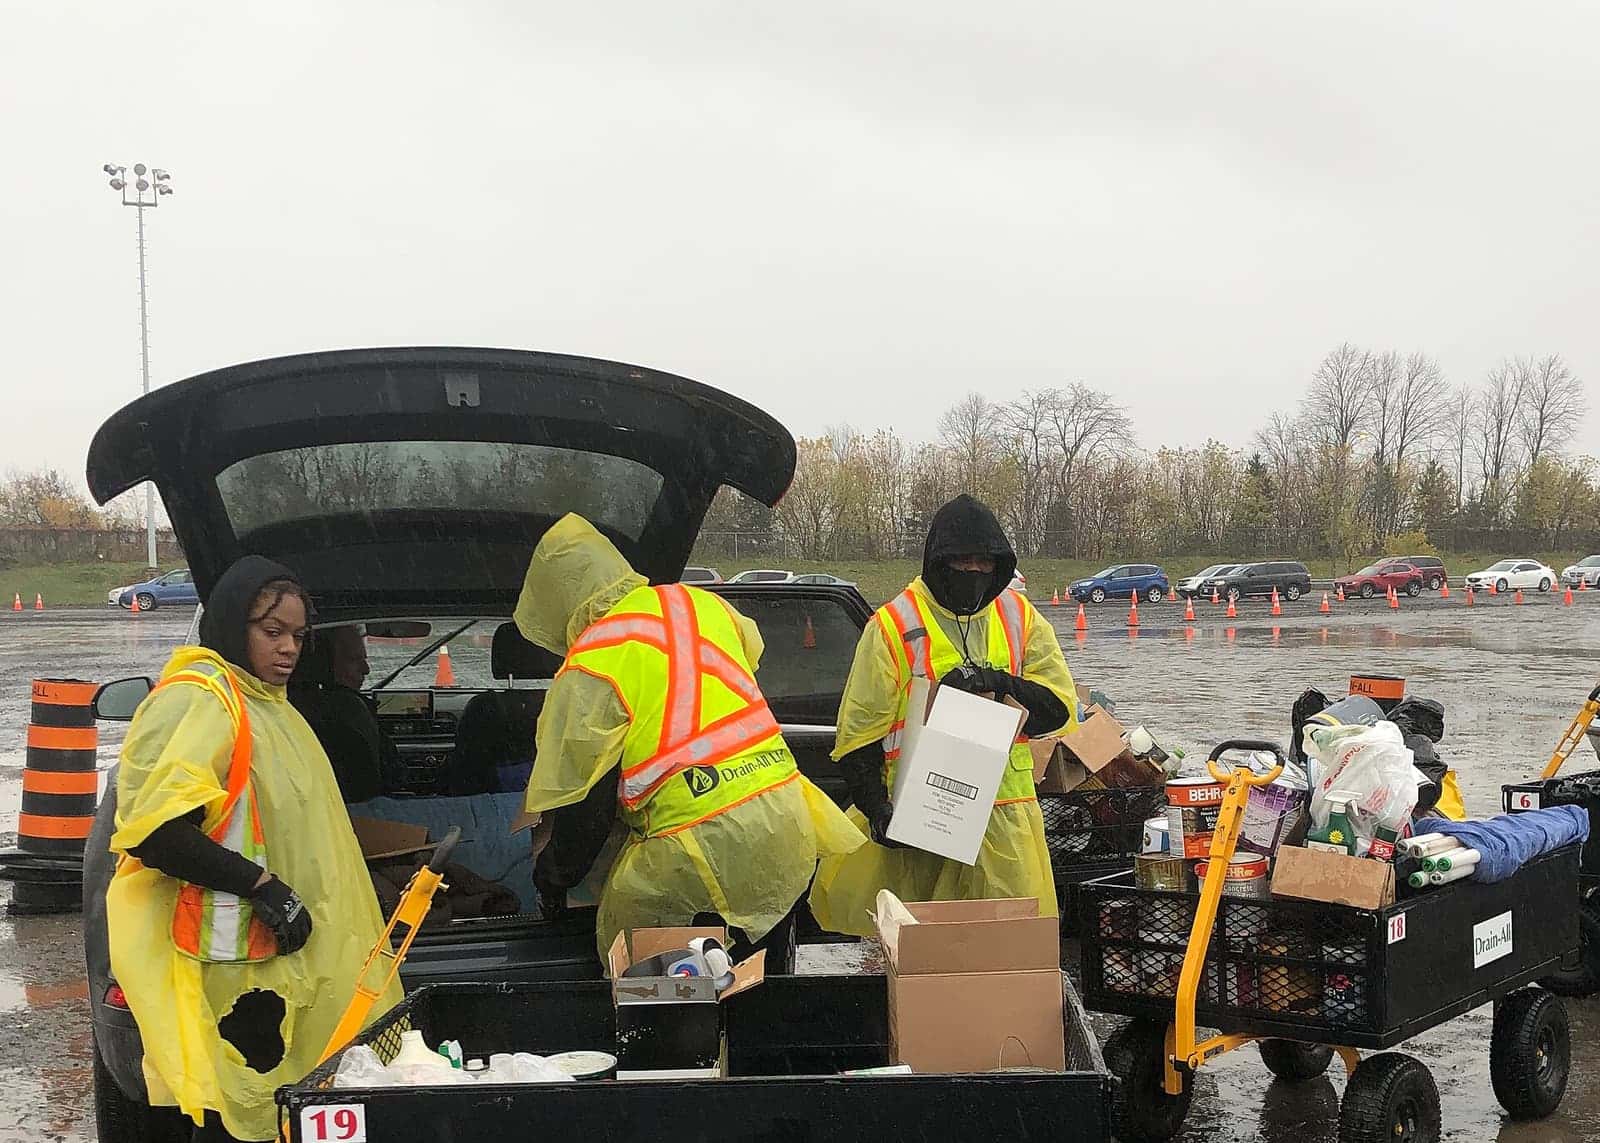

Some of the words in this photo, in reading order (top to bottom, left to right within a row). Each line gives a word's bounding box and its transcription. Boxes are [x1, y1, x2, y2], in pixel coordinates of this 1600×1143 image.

[721, 753, 772, 783] Drain-All
[1188, 787, 1221, 802] BEHR
[1520, 794, 1531, 808] 6
[1389, 917, 1404, 941] 18
[1475, 922, 1511, 956] Drain-All
[309, 1108, 358, 1140] 19
